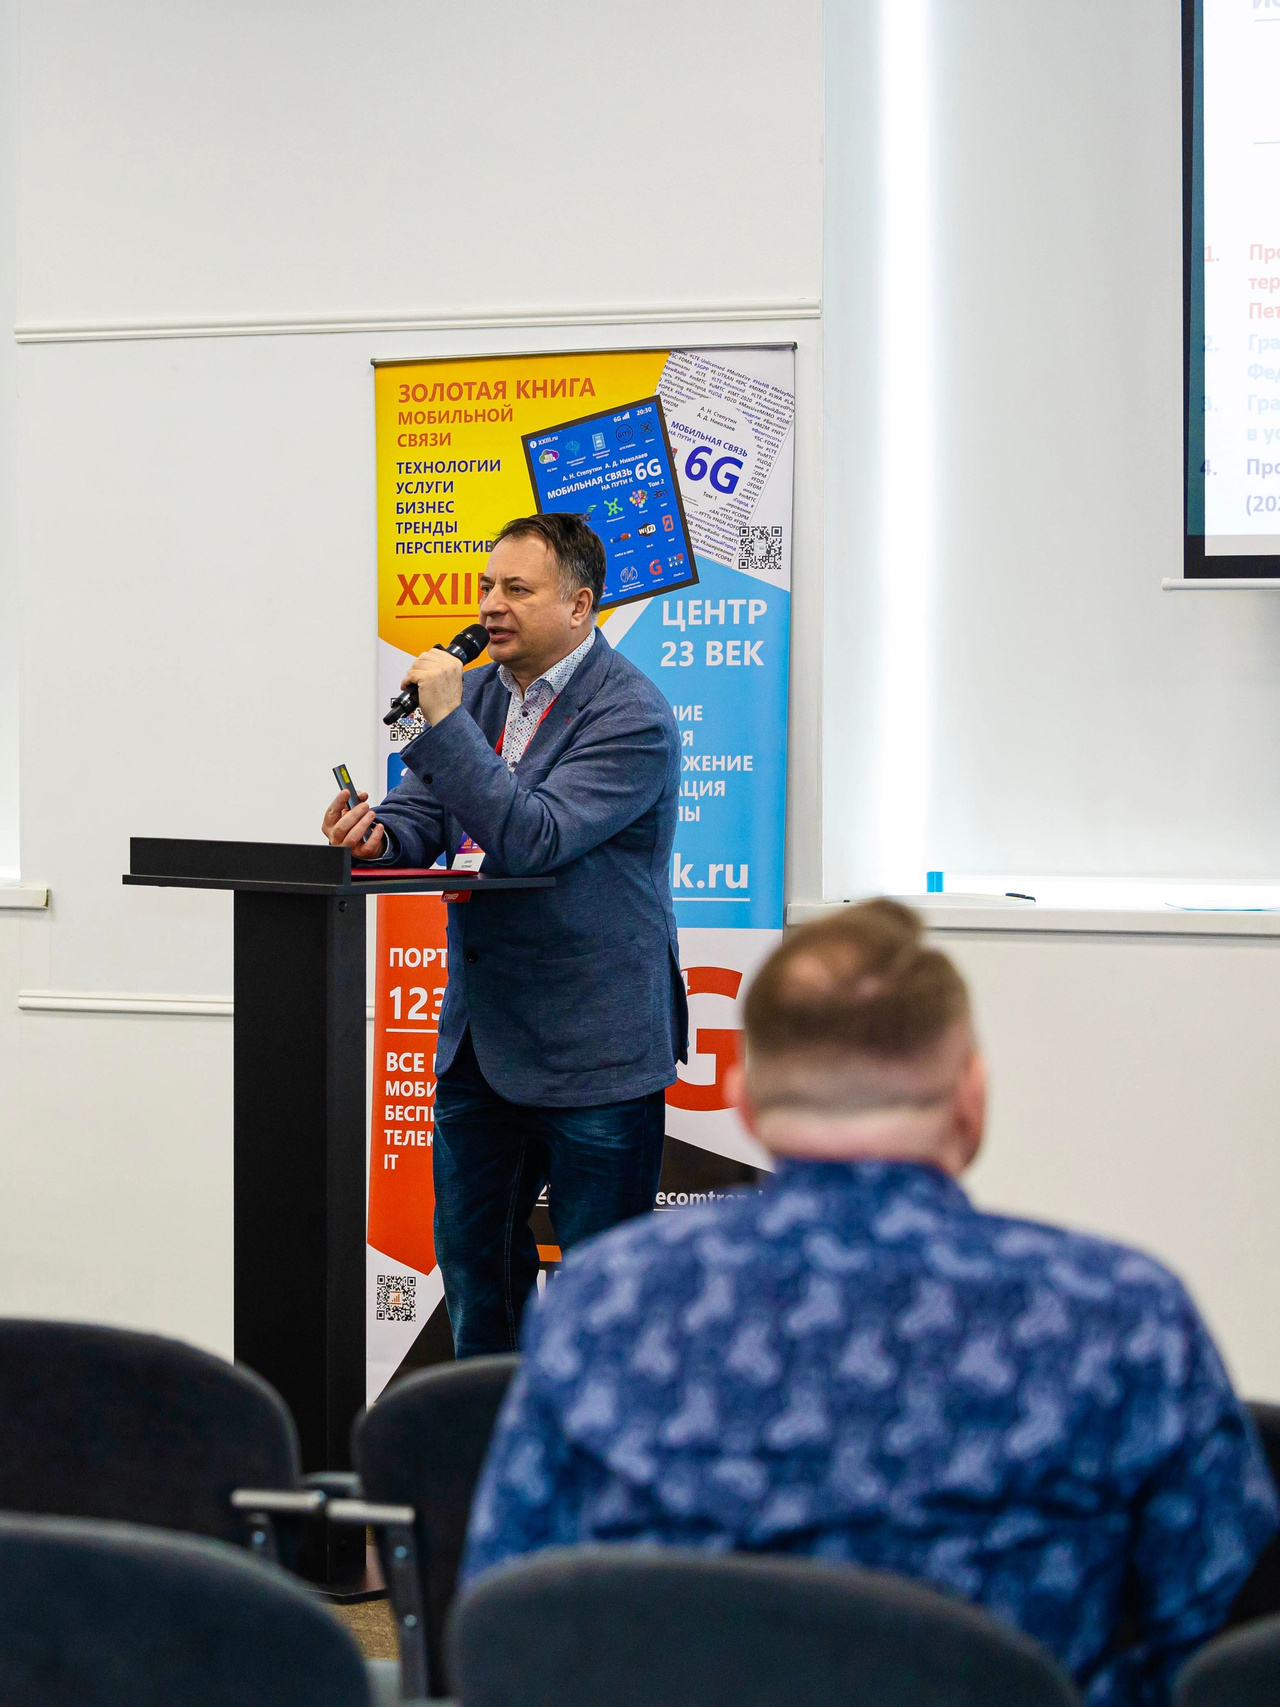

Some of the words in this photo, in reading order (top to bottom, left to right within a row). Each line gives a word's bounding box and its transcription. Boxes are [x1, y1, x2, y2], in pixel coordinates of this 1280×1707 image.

[398, 380, 507, 404] ЗОЛОТАЯ
[516, 377, 596, 400] КНИГА
[398, 404, 514, 426] МОБИЛЬНОЙ
[613, 415, 622, 423] 6G
[636, 406, 653, 416] 20:30
[707, 408, 713, 416] Н.
[714, 411, 738, 425] Степутин
[696, 412, 703, 420] А.
[710, 418, 736, 432] Николаев
[397, 432, 452, 448] СВЯЗИ
[669, 429, 677, 437] НА
[676, 432, 694, 443] ПУТИ
[670, 420, 723, 447] МОБИЛЬНАЯ
[723, 441, 749, 458] СВЯЗЬ
[396, 459, 502, 475] ТЕХНОЛОГИИ
[684, 446, 744, 495] 6G
[396, 480, 454, 495] УСЛУГИ
[547, 476, 604, 500] МОБИЛЬНАЯ
[604, 468, 633, 482] СВЯЗЬ
[634, 458, 662, 480] 6G
[611, 479, 629, 490] ПУТИ
[703, 491, 714, 500] Том
[396, 500, 455, 515] БИЗНЕС
[395, 520, 458, 537] ТРЕНДЫ
[662, 599, 767, 632] ЦЕНТР
[661, 641, 694, 667] 23
[706, 640, 764, 666] ВЕК
[672, 852, 749, 889] k.ru
[389, 947, 447, 968] ПОРТ
[386, 1052, 425, 1072] ВСЕ
[383, 1154, 399, 1170] IT
